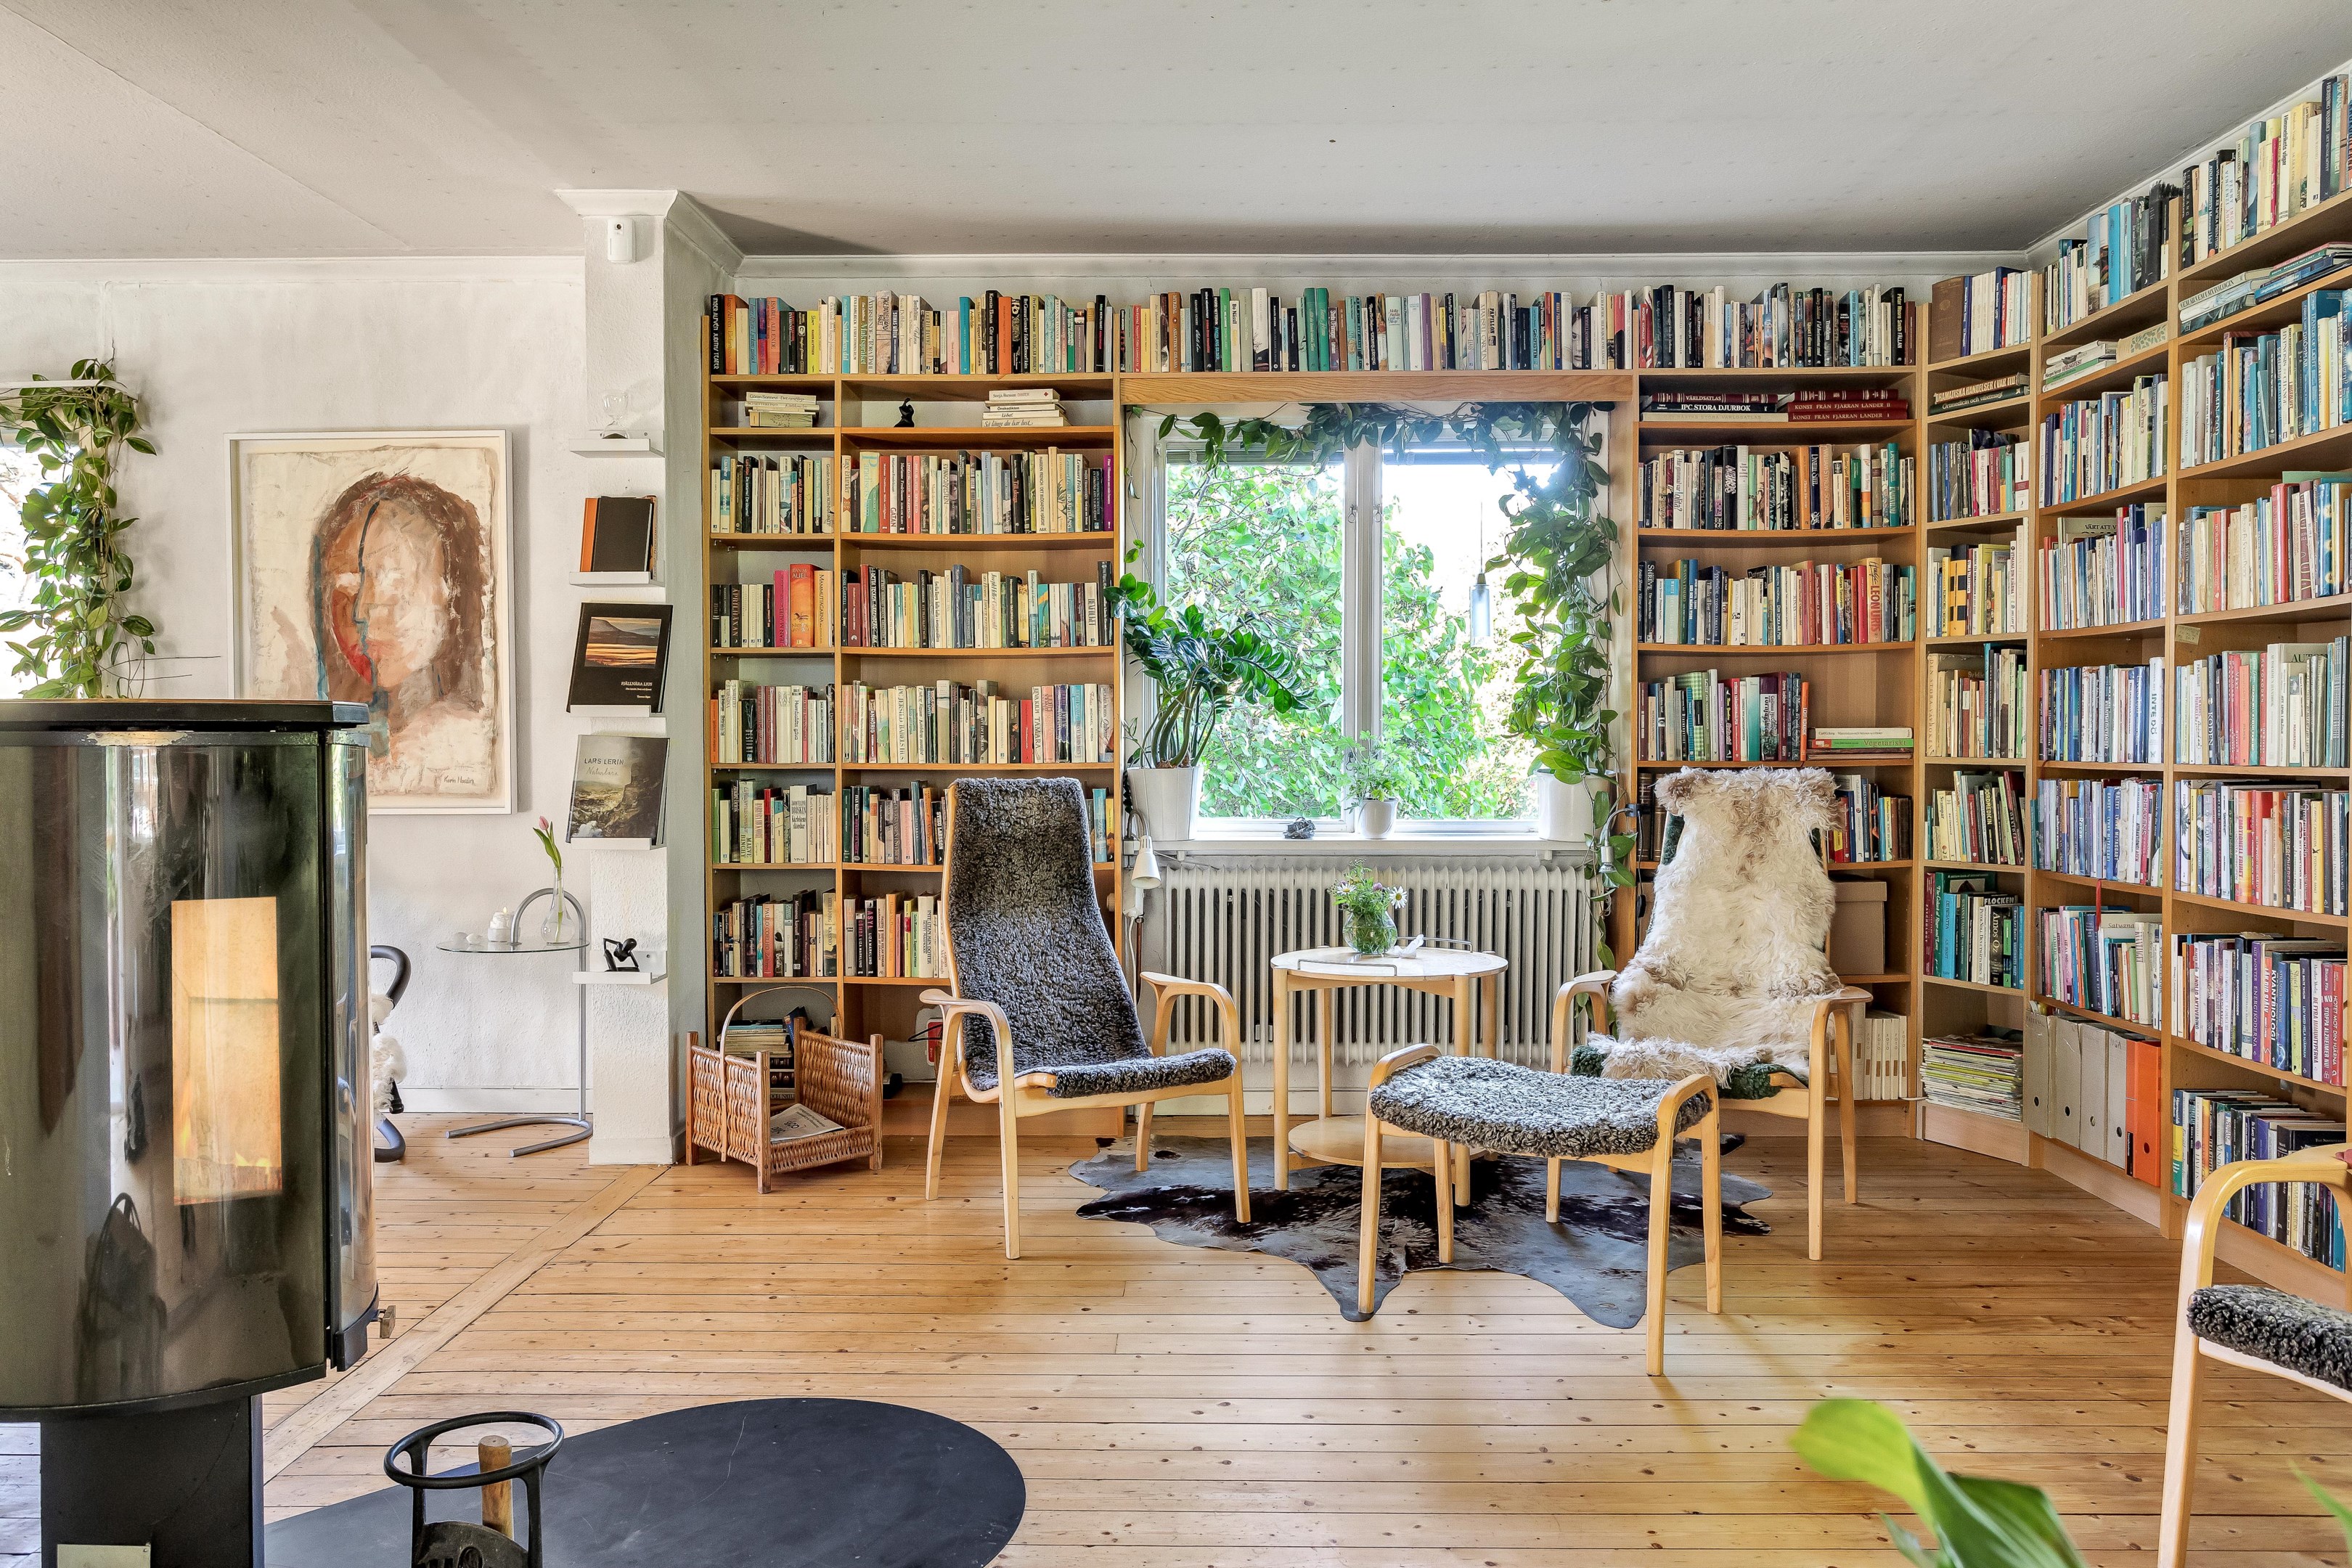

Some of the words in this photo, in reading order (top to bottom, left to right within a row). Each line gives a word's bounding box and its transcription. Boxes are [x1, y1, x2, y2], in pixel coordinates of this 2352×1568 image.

[1871, 585, 1879, 608] LEON
[1871, 611, 1881, 632] URIS
[1992, 912, 2001, 936] Amos
[1993, 940, 2001, 952] Oz
